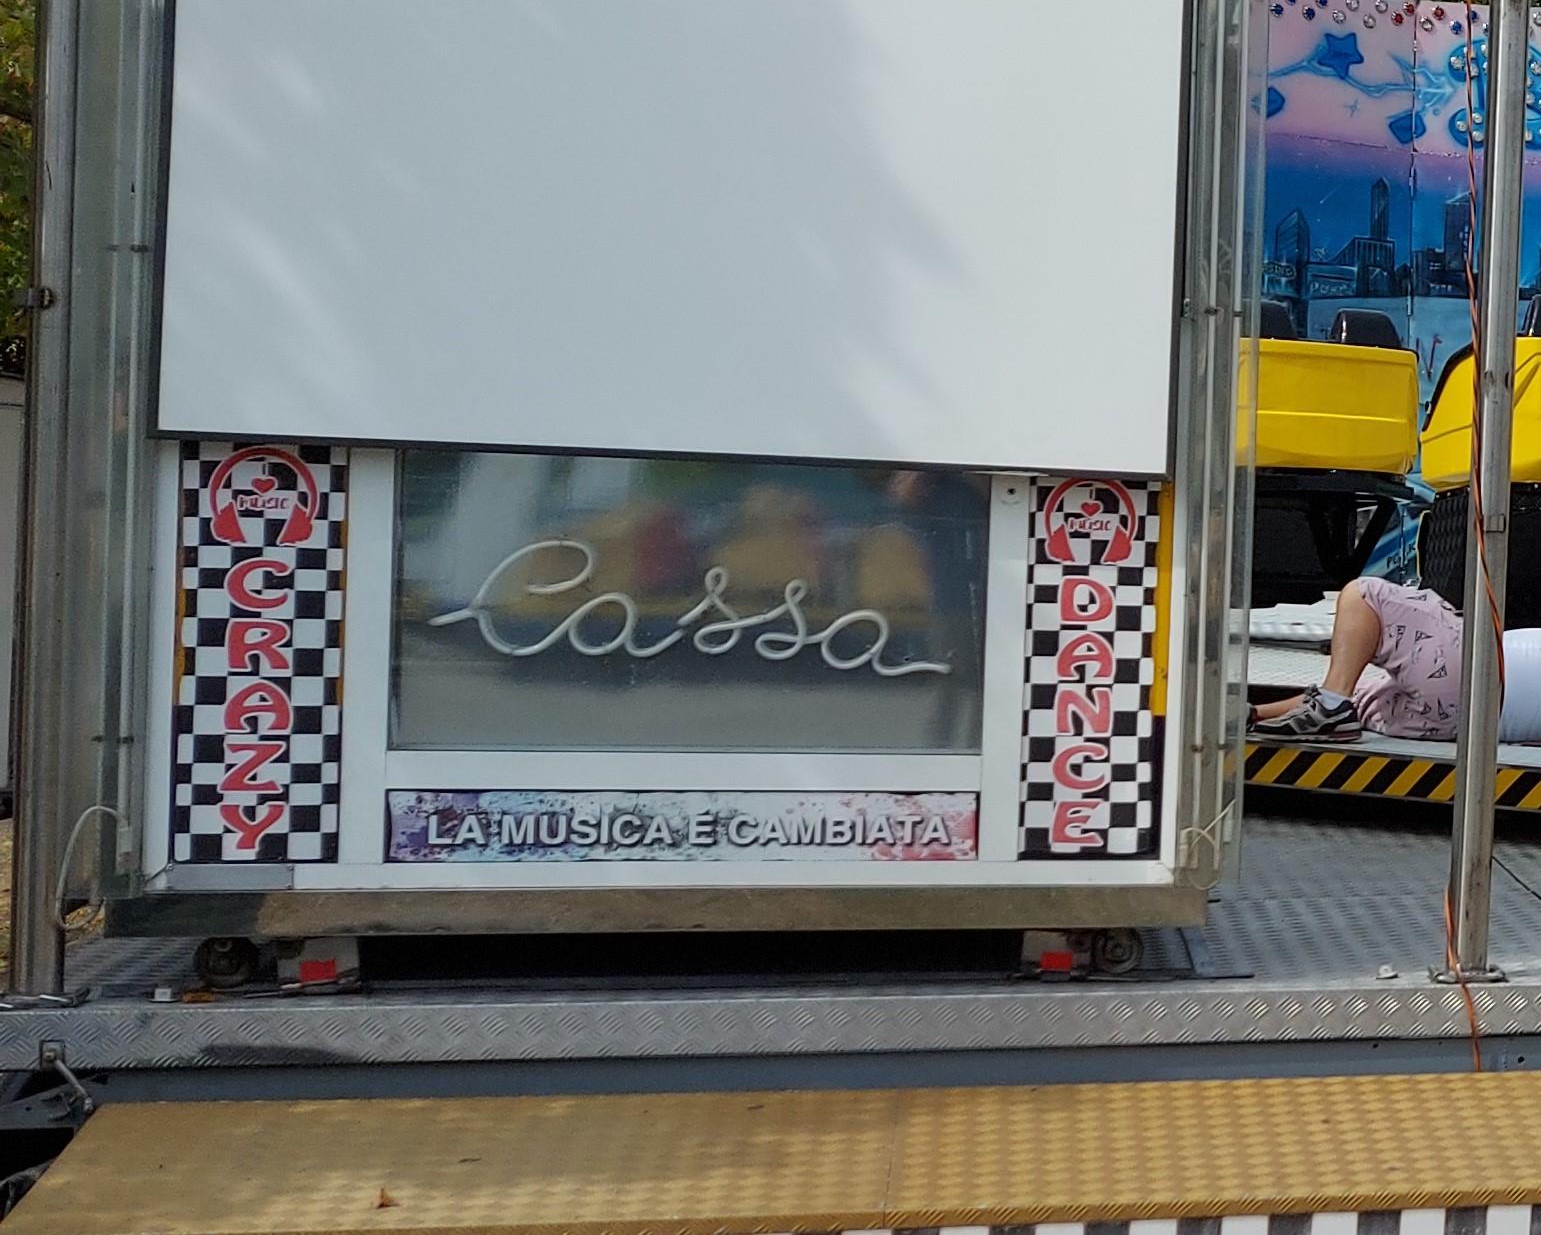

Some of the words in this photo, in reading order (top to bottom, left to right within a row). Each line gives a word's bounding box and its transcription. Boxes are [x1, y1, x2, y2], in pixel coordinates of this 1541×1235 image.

[218, 558, 293, 853] CRAZY
[428, 539, 952, 678] Cassa
[1050, 575, 1115, 850] DANCE
[427, 813, 487, 846] LA
[500, 813, 674, 846] MUSICA
[727, 812, 951, 847] CAMBIATA
